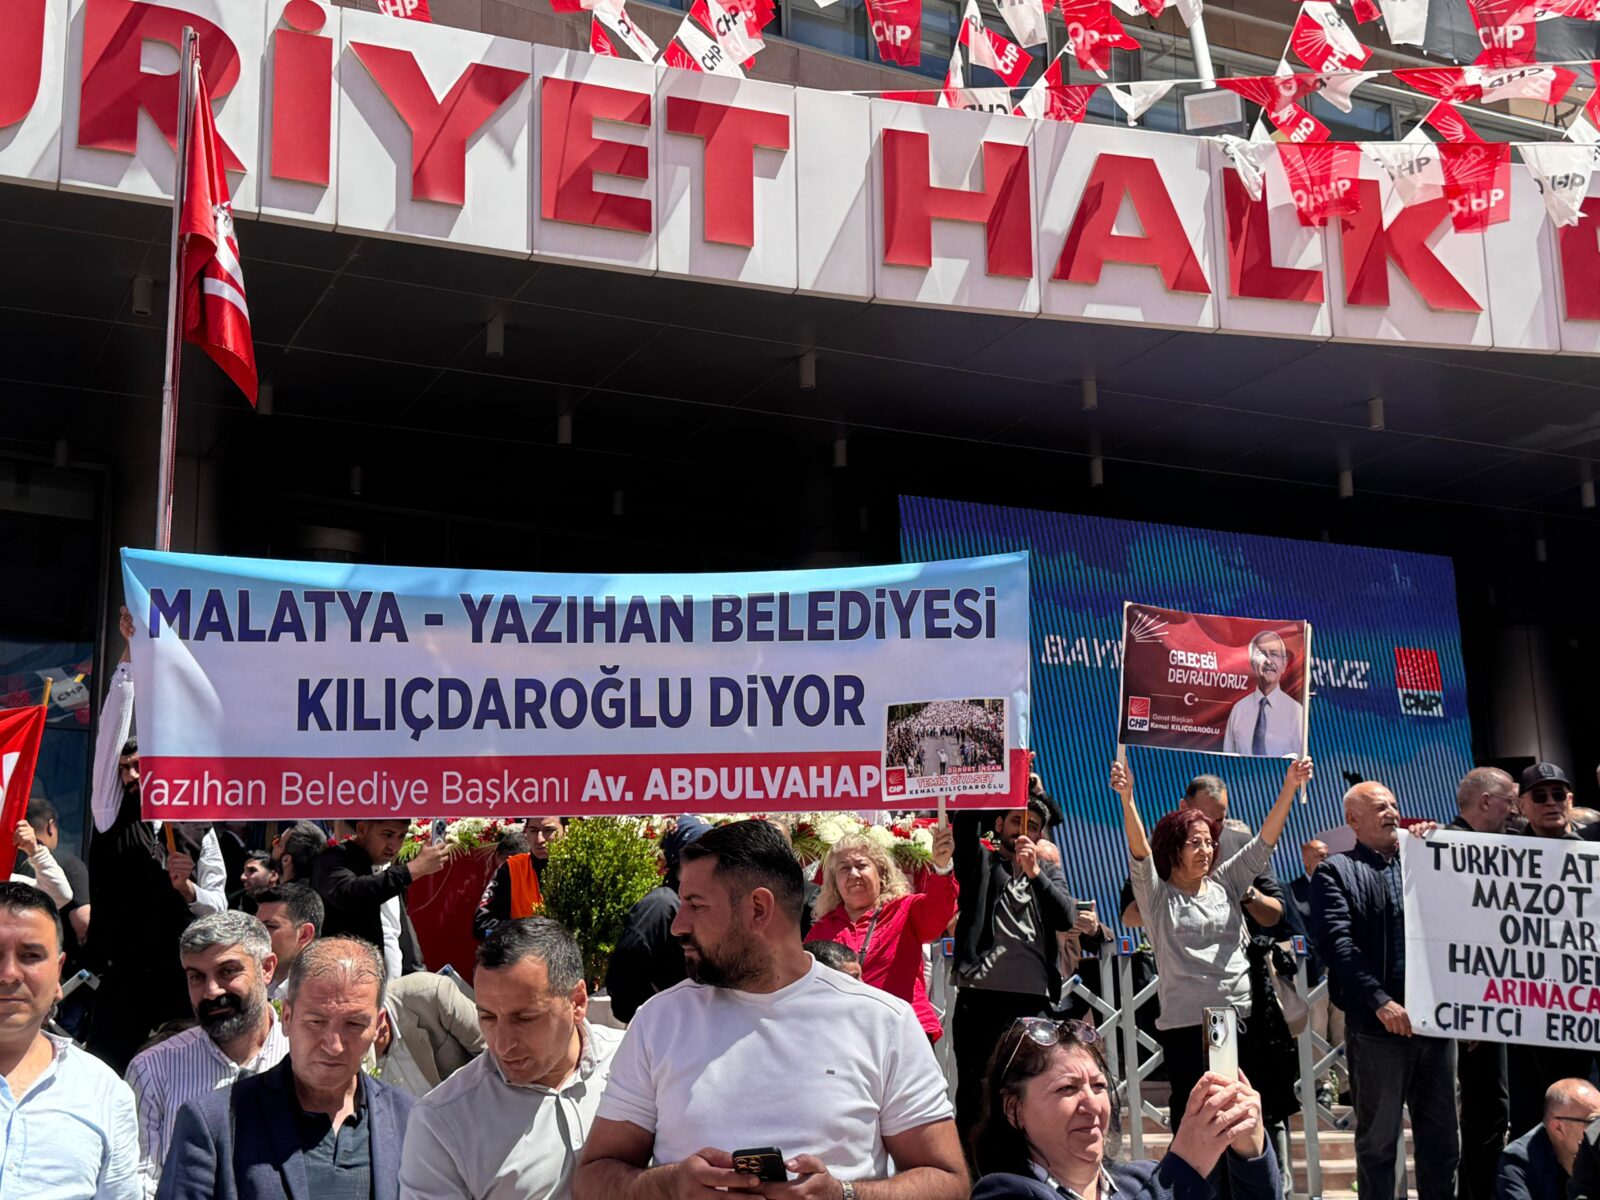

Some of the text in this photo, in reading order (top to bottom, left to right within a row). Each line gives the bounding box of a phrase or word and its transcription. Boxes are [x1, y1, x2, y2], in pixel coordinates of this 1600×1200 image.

[872, 20, 912, 47] CHP
[1479, 25, 1525, 49] CHP
[701, 45, 724, 71] CHP
[1000, 42, 1020, 75] CHP
[882, 128, 1484, 314] HALK
[149, 586, 997, 644] MALATYA - YAZIHAN BELEDİYESİ
[1169, 649, 1218, 670] GELECEĞİ
[1167, 668, 1249, 690] DEVRALIYORUZ
[297, 665, 865, 742] KILIÇDAROĞLU DİYOR
[1152, 713, 1170, 721] Genel
[1128, 717, 1148, 729] CHP
[1170, 724, 1221, 735] KILIÇDAROĞLU
[281, 770, 429, 811] Belediye
[442, 768, 569, 810] Başkanı
[580, 768, 634, 802] Av.
[643, 764, 880, 801] ABDULVAHAP
[888, 785, 904, 794] CHP
[939, 783, 1005, 794] KILIÇDAROĞLU
[1426, 841, 1543, 879] TÜRKİYE
[1472, 878, 1593, 918] MAZOT
[1499, 914, 1598, 953] ONLAR
[1434, 1002, 1522, 1038] ÇİFTÇİ
